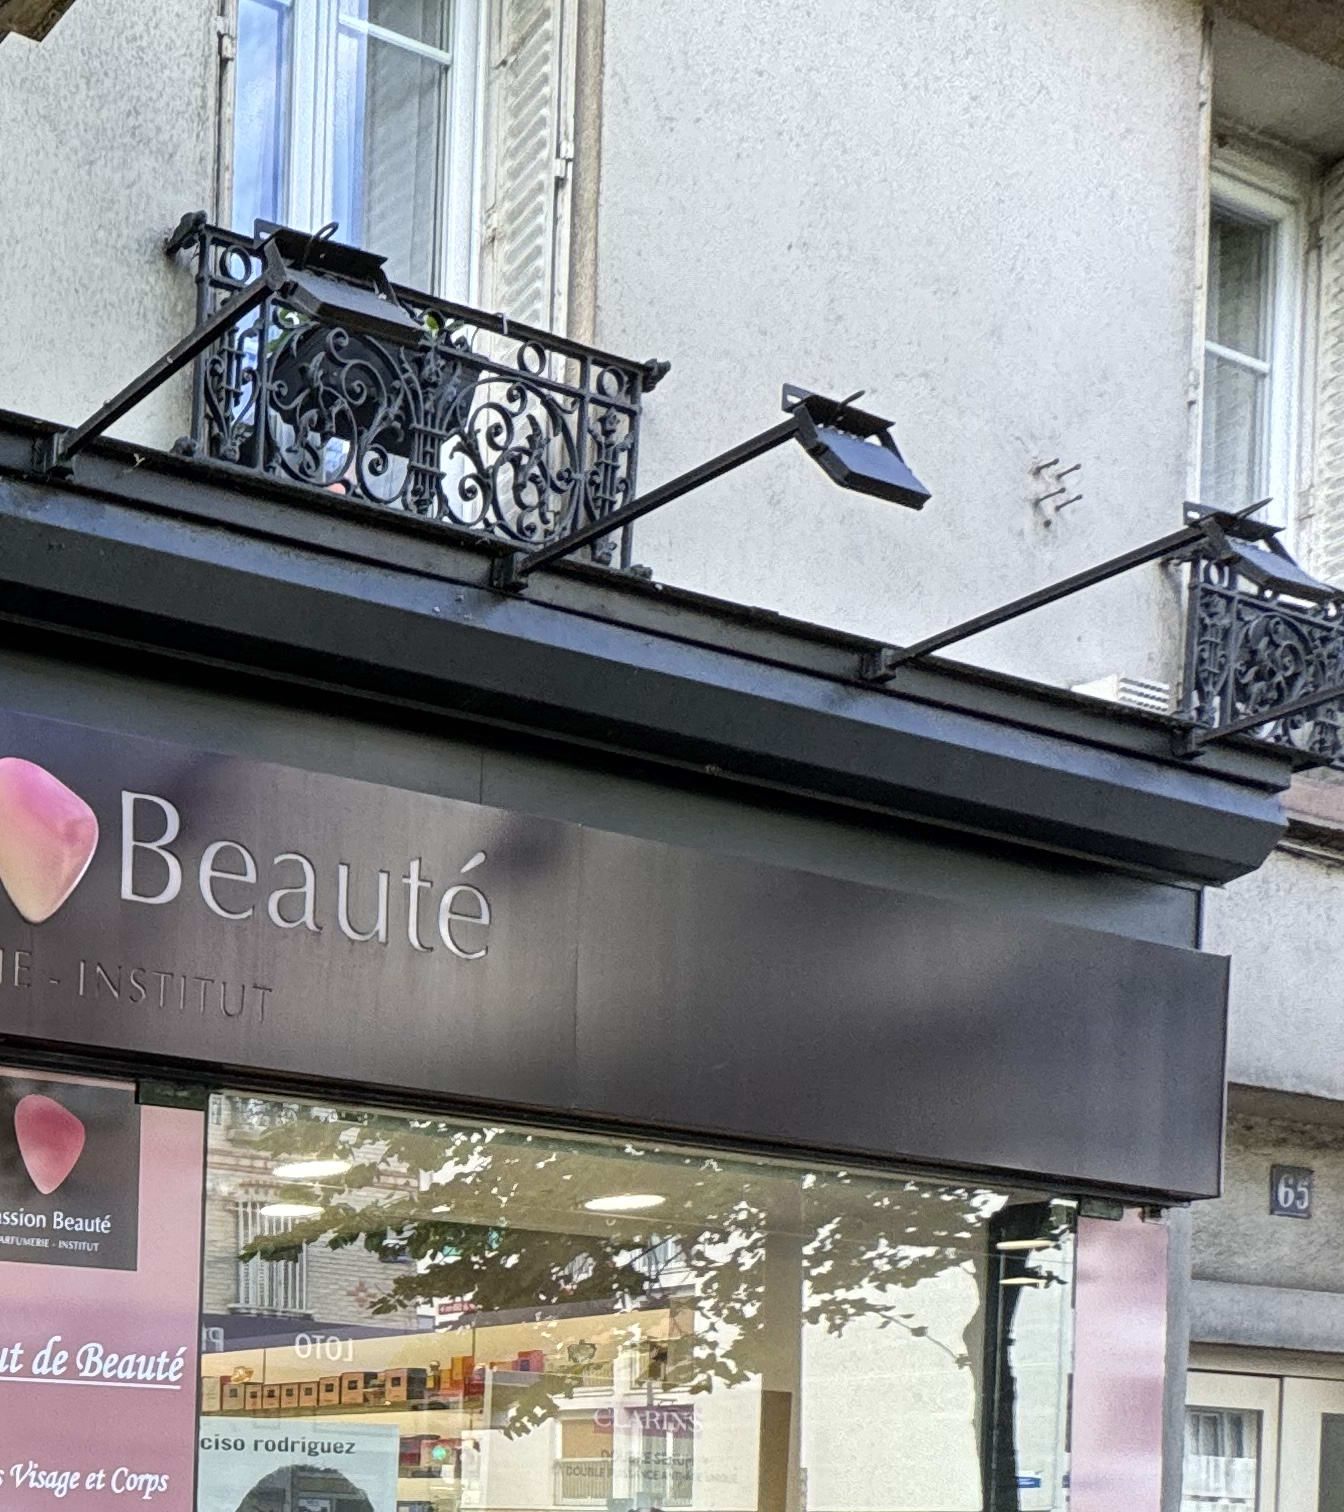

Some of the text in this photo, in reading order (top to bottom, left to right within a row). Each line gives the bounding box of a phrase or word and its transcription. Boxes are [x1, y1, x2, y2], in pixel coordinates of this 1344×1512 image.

[119, 790, 493, 961] Beauté
[78, 962, 273, 1023] INSTITUT
[53, 1211, 112, 1233] Beauté
[58, 1239, 99, 1252] INSTITUT
[31, 1335, 68, 1377] de
[76, 1342, 187, 1383] Beauté
[595, 1408, 705, 1433] CLARINS
[200, 1434, 356, 1457] ciso rodriguez
[10, 1463, 79, 1498] Visage
[85, 1468, 105, 1489] et
[111, 1466, 169, 1499] Corps
